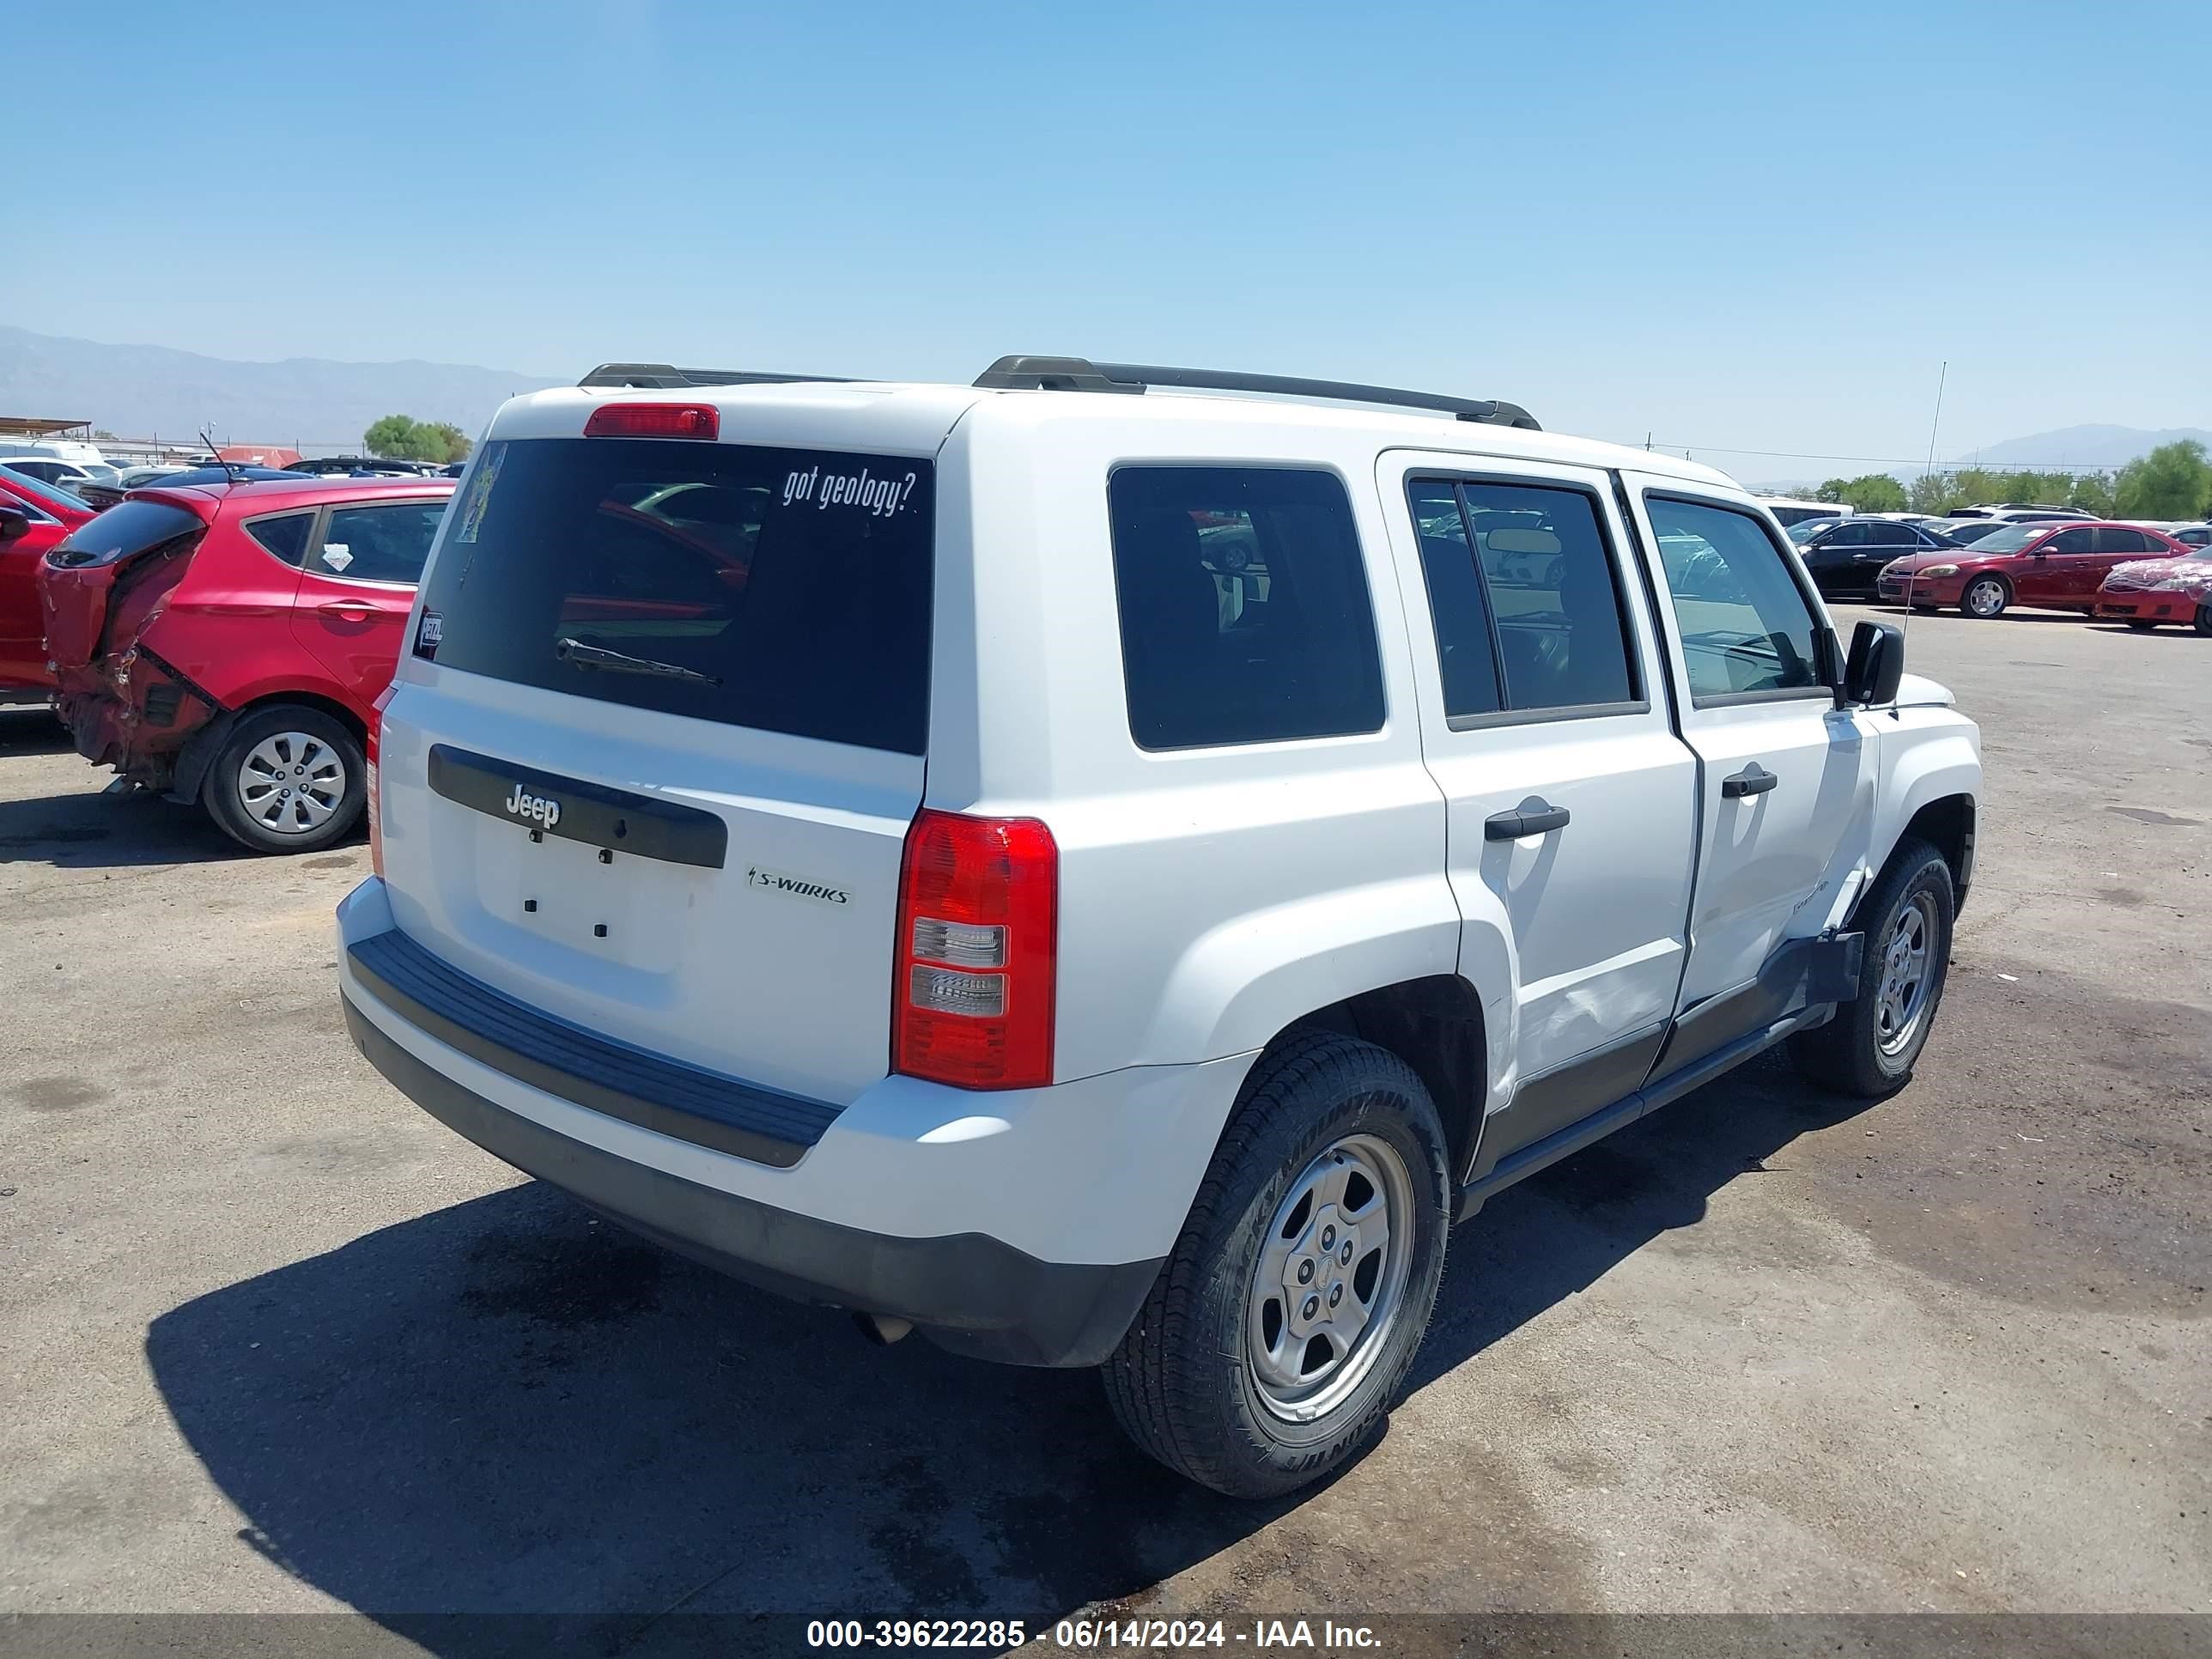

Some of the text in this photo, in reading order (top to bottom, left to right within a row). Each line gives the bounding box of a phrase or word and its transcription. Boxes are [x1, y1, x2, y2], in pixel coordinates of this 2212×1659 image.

[782, 465, 916, 517] got geology?
[506, 783, 560, 830] Jeep
[757, 873, 851, 903] S-WORKS
